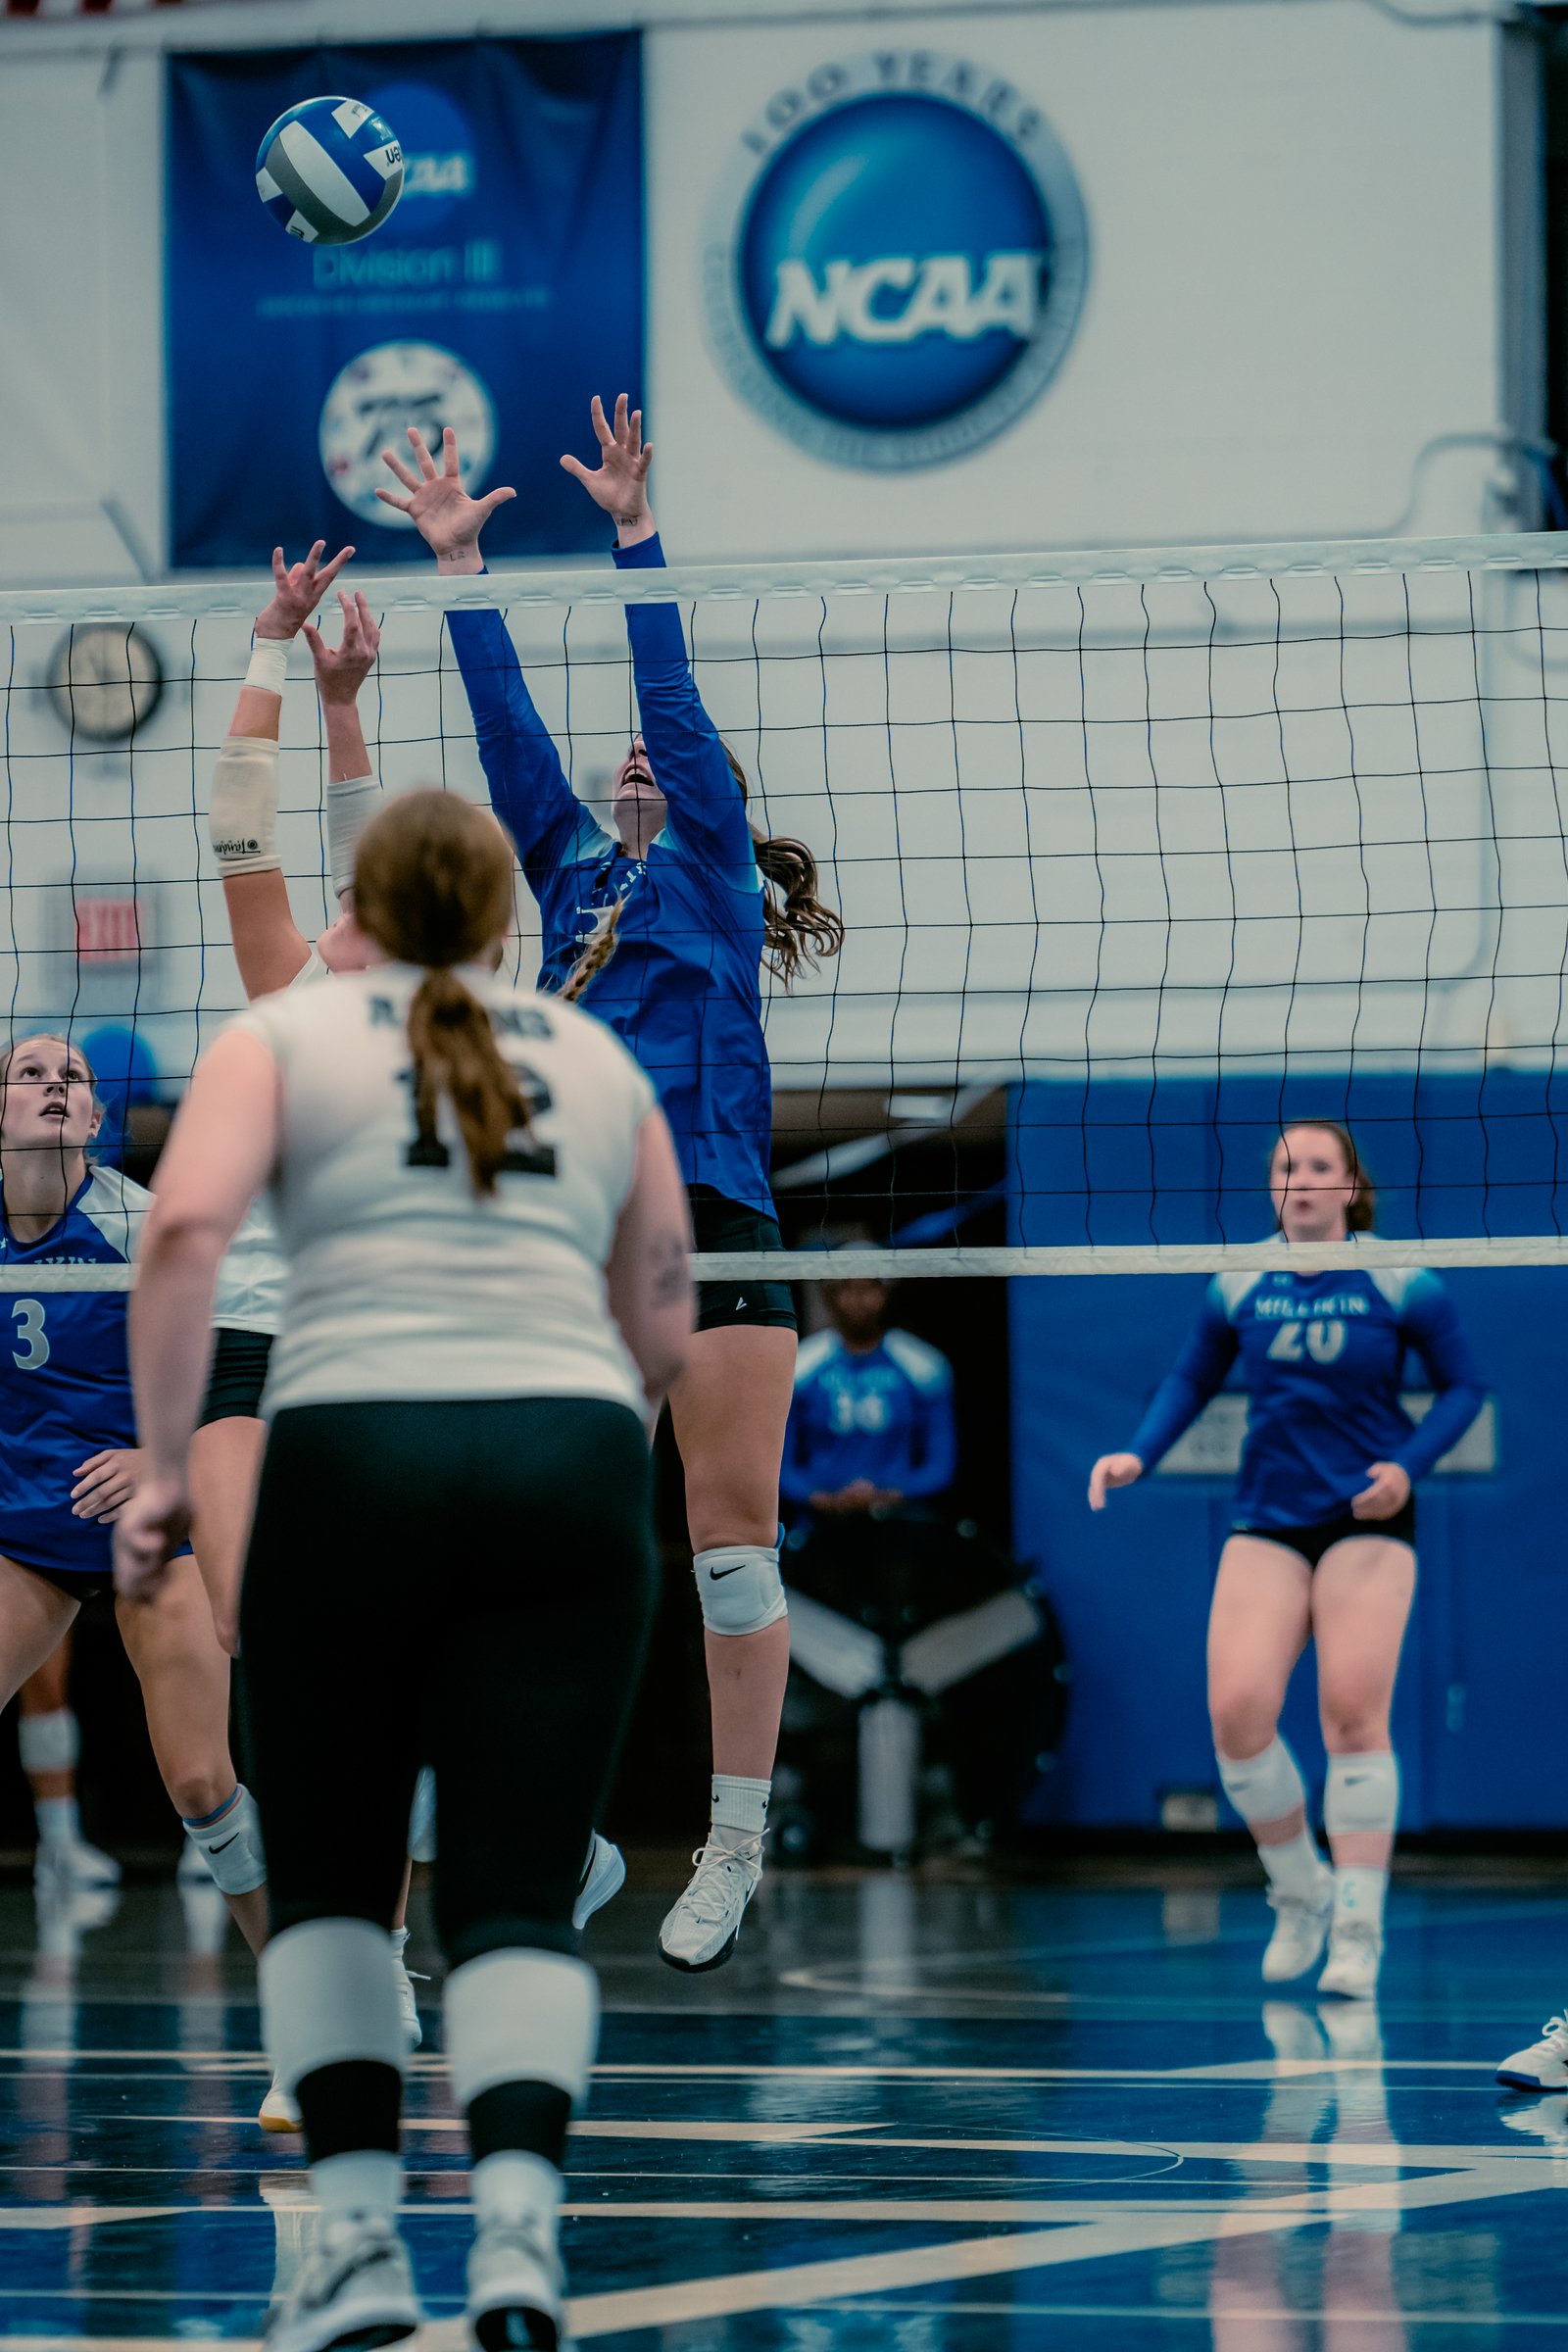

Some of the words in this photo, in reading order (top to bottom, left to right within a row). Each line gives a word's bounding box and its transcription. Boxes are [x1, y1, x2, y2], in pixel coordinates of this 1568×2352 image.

[313, 244, 453, 289] Division
[765, 251, 1041, 351] NCAA
[11, 1298, 50, 1370] 3
[1267, 1318, 1345, 1365] 20
